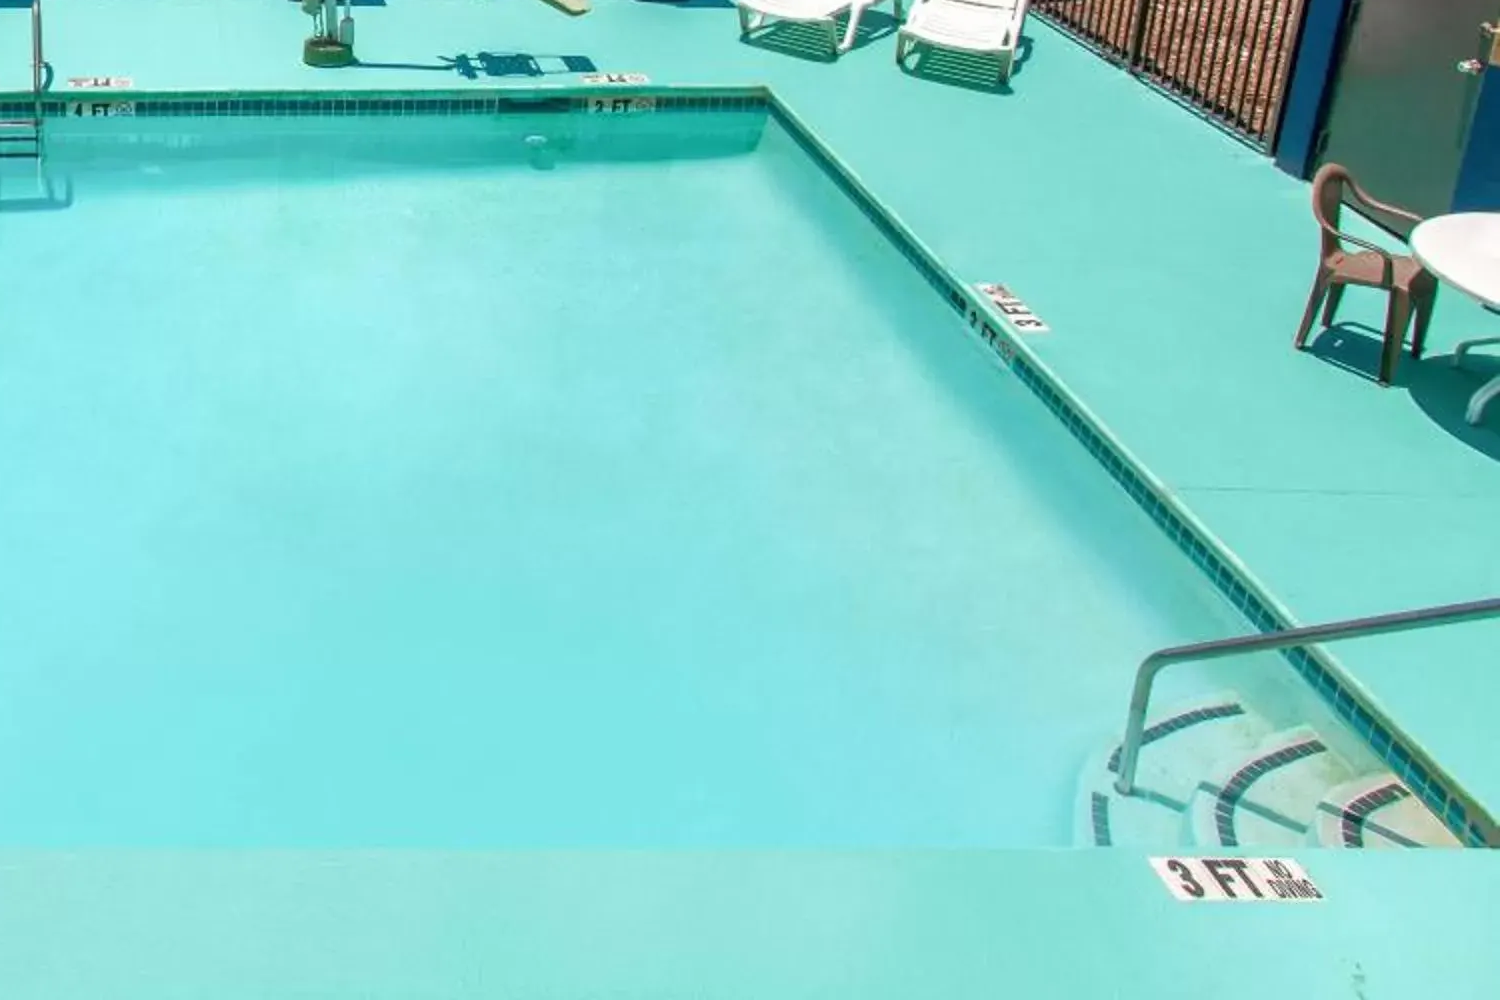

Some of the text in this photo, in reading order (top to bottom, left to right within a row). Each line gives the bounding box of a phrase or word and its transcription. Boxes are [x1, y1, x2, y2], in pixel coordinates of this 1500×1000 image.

[91, 103, 111, 116] FT
[612, 99, 632, 112] FT
[1167, 859, 1264, 898] 3 FT
[1262, 859, 1293, 880] NO
[1266, 878, 1323, 899] DIVING
